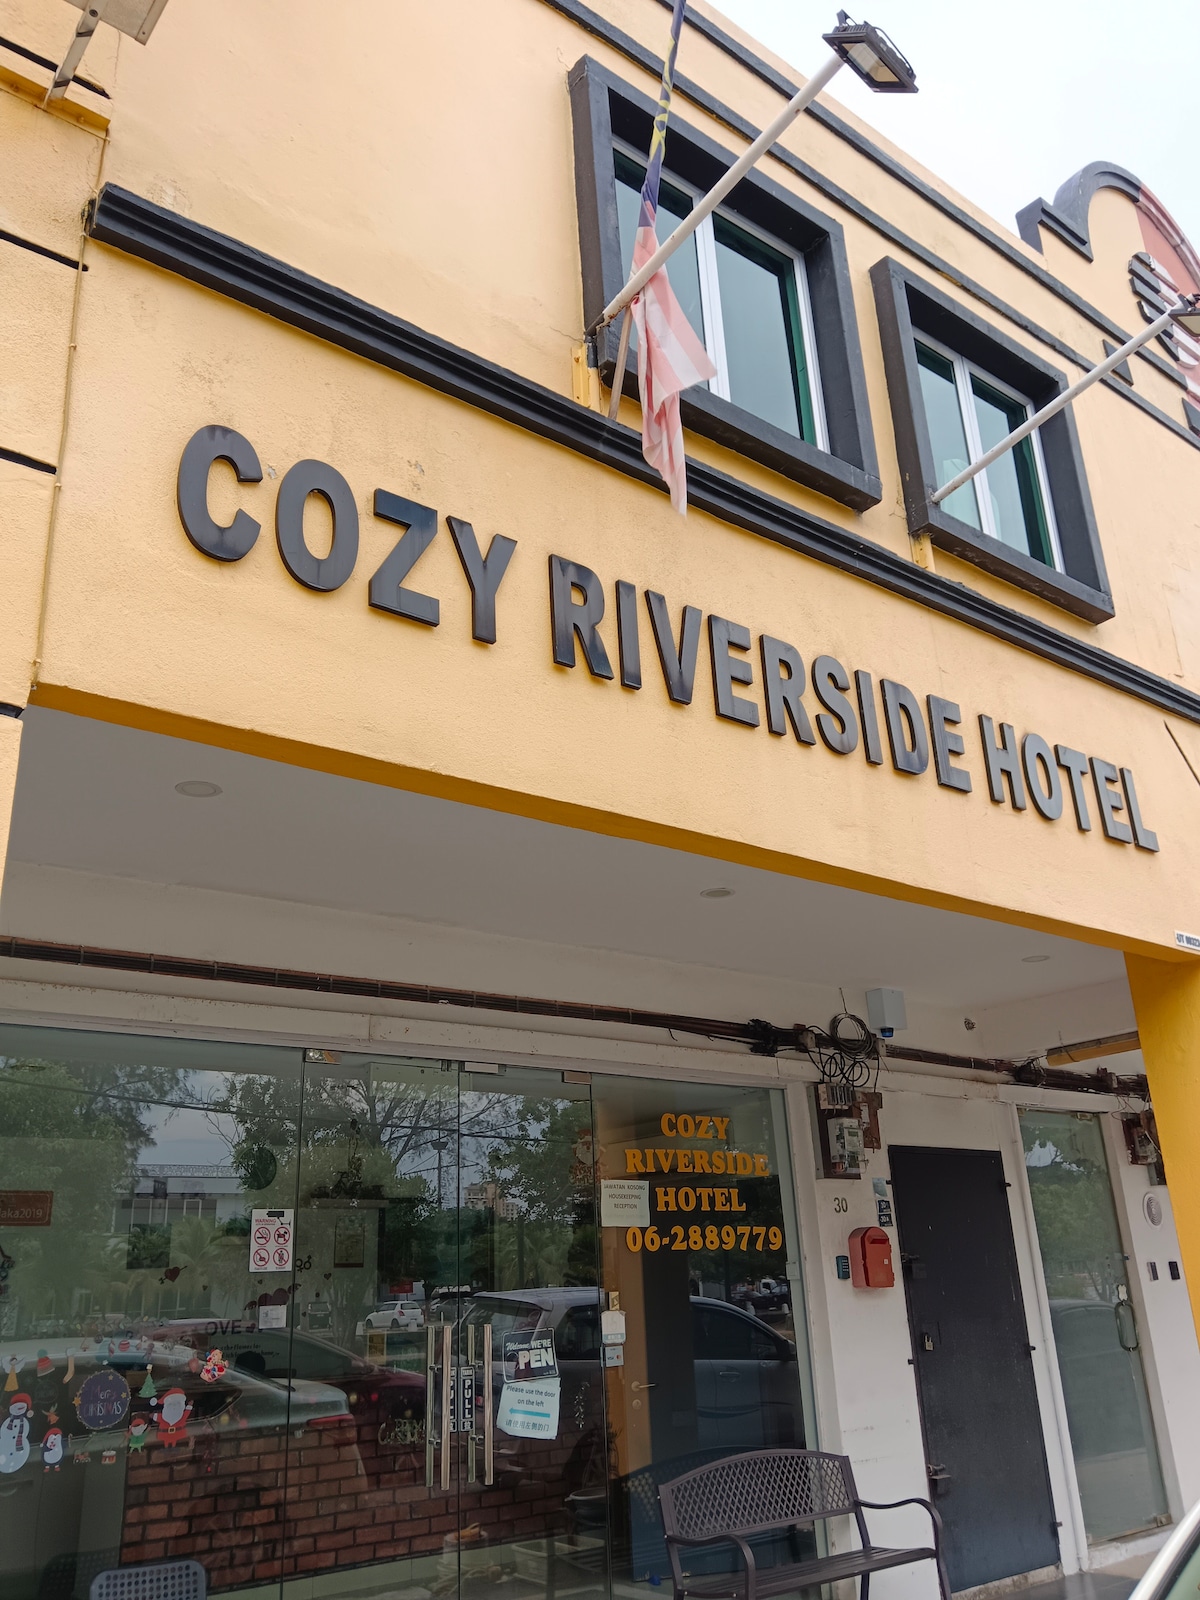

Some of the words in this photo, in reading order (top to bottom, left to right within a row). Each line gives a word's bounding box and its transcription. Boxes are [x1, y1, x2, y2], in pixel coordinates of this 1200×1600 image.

[177, 424, 518, 645] COZY
[548, 553, 973, 794] RIVERSIDE
[978, 714, 1160, 853] HOTEL
[660, 1112, 730, 1140] COZY
[625, 1149, 770, 1177] RIVERSIDE
[655, 1187, 747, 1212] HOTEL
[833, 1197, 849, 1214] 30
[625, 1225, 783, 1252] 06-2889779
[505, 1341, 530, 1351] Welcome
[530, 1338, 552, 1349] WE'RE
[464, 1379, 472, 1418] PULL
[506, 1384, 525, 1394] Please
[534, 1389, 543, 1397] the
[544, 1390, 556, 1398] door
[525, 1398, 535, 1406] the
[535, 1399, 545, 1407] left
[505, 1418, 550, 1432] 请使用左侧的门
